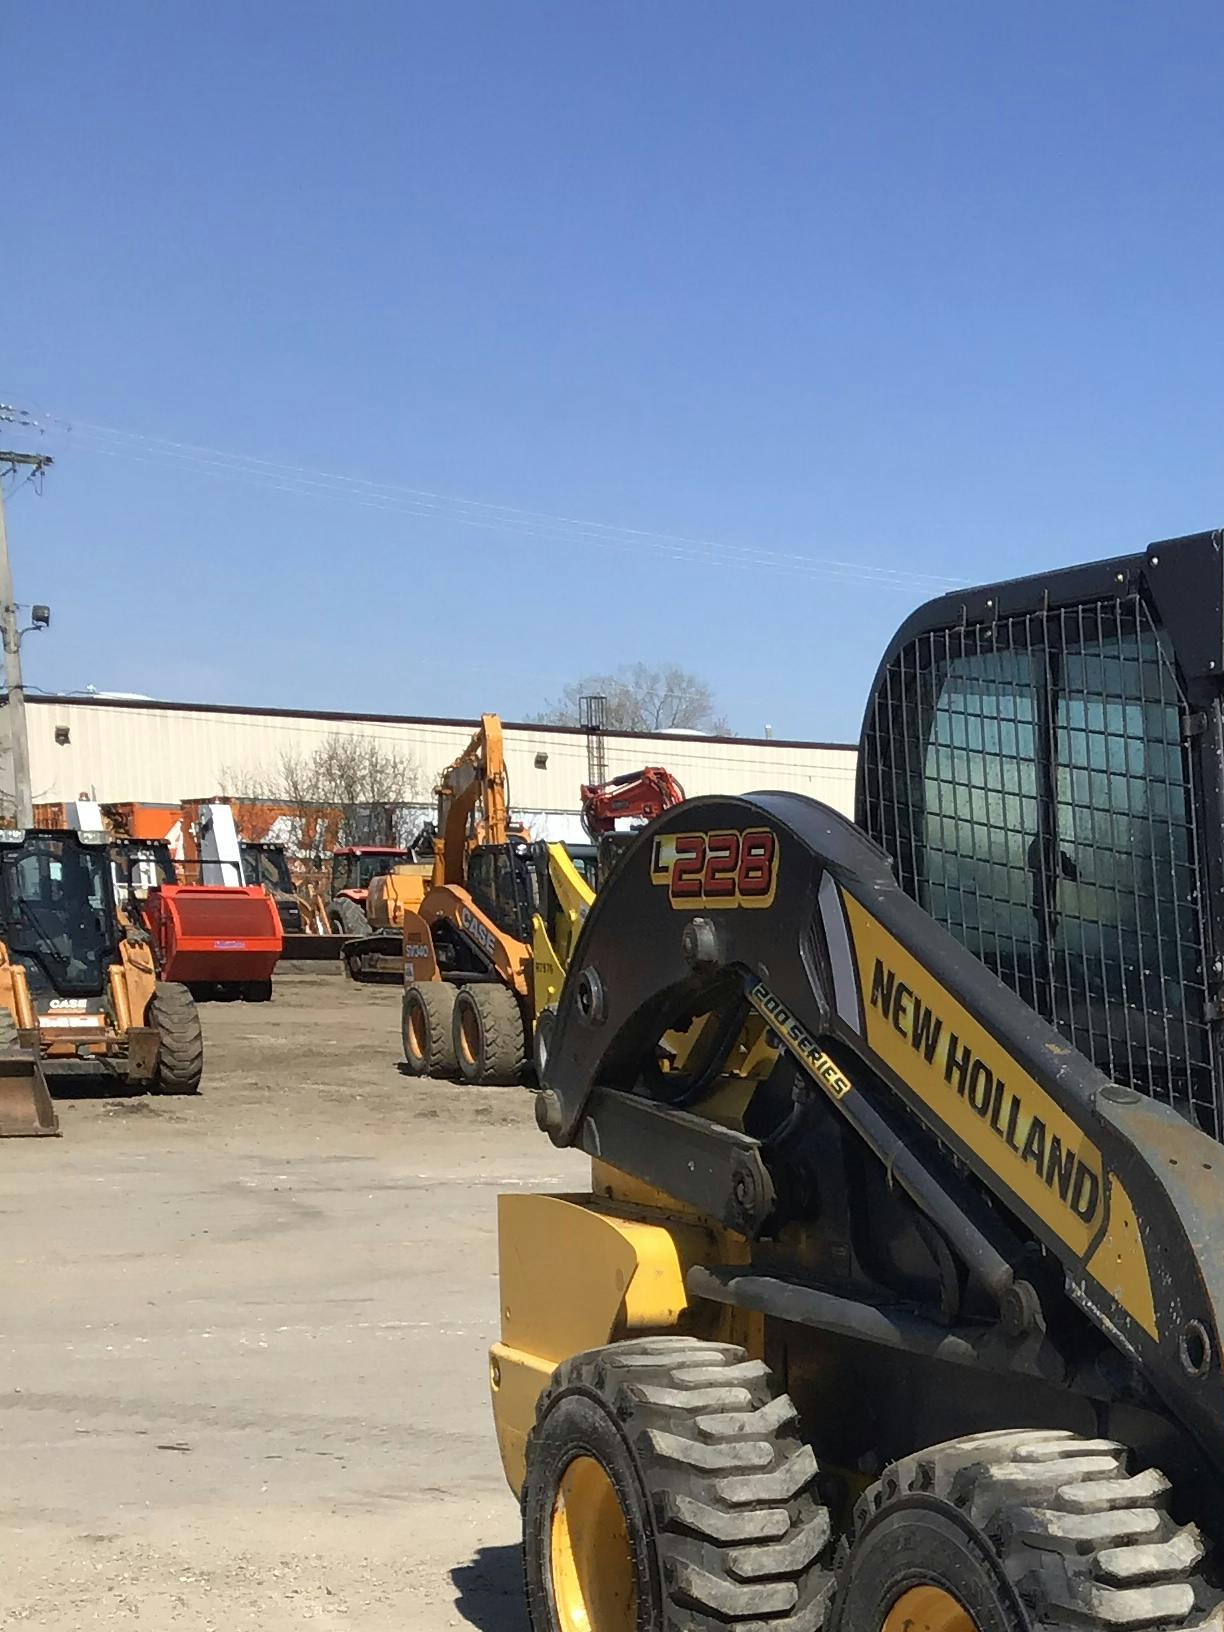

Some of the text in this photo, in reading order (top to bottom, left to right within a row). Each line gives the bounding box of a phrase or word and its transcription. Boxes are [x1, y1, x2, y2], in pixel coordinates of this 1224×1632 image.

[652, 832, 774, 899] L228
[461, 907, 497, 954] CASE
[49, 999, 88, 1009] CASE
[752, 983, 851, 1097] 200 SERIES
[870, 957, 1099, 1224] NEW HOLLAND
